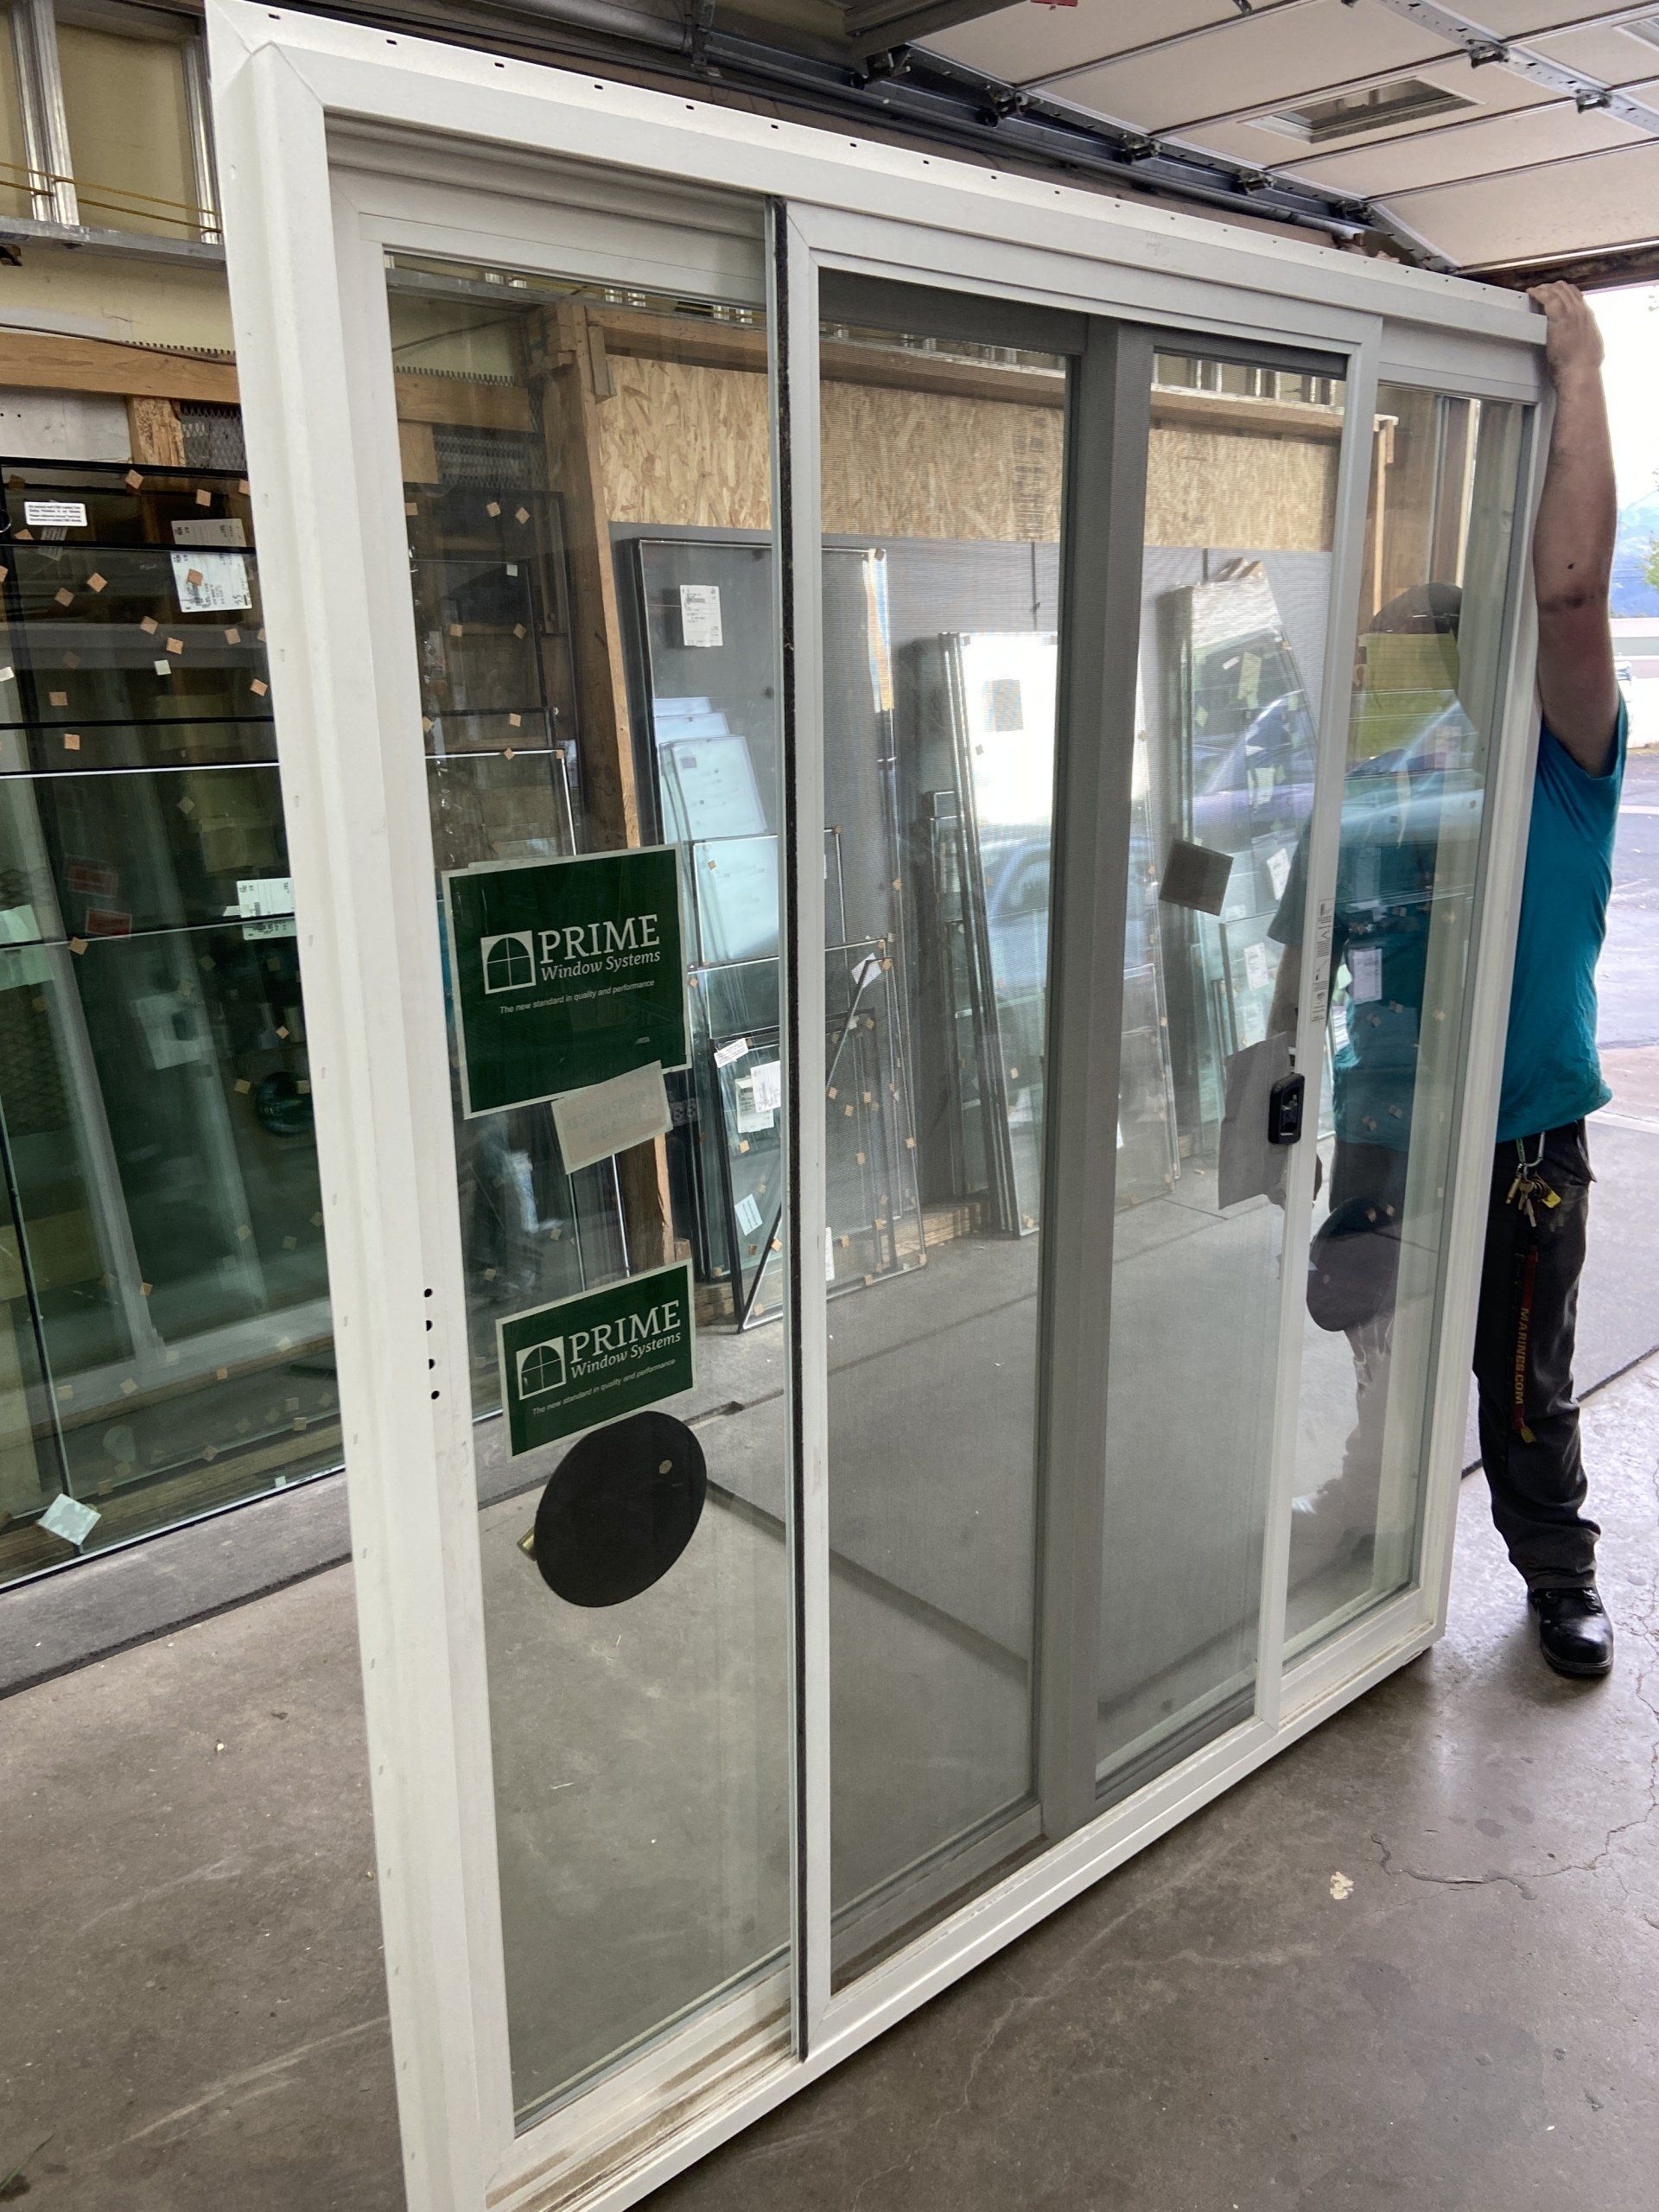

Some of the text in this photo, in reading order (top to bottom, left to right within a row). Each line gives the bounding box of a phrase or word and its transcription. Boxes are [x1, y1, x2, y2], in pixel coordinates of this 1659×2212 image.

[537, 914, 660, 964] PRIME
[541, 950, 661, 981] Window Systems
[499, 1006, 514, 1014] The
[516, 1002, 532, 1012] new
[532, 995, 564, 1008] standard
[574, 990, 596, 1002] quality
[598, 987, 611, 996] and
[612, 980, 655, 995] performance
[568, 1300, 681, 1364] PRIME
[570, 1332, 681, 1379] Window Systems
[532, 1406, 546, 1415] The
[623, 1372, 636, 1382] and
